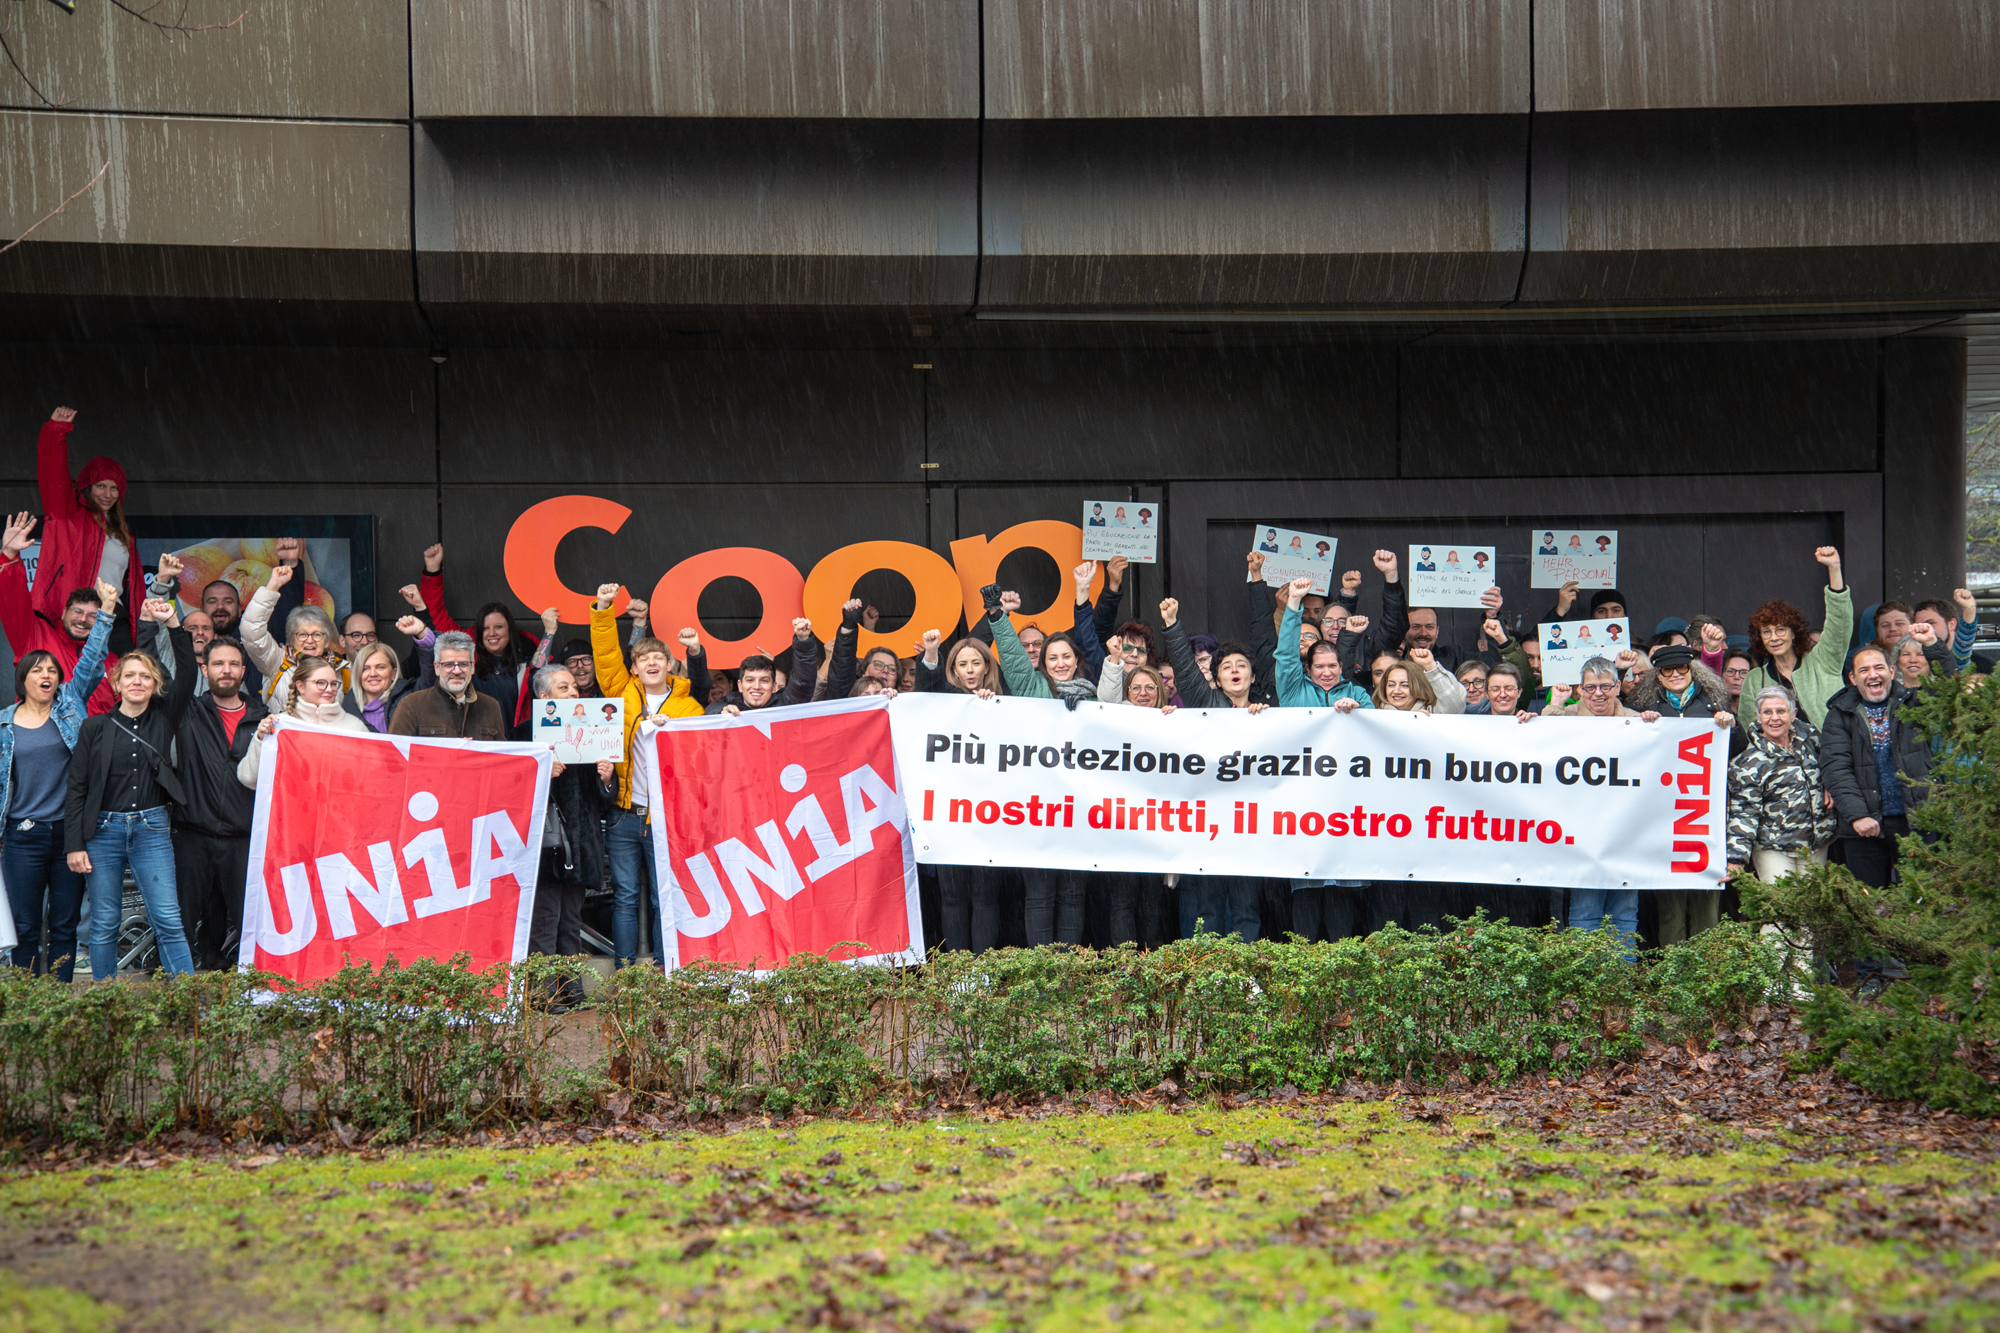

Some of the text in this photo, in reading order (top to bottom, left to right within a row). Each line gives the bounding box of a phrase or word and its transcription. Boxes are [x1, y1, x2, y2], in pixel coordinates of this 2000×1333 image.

[1542, 557, 1574, 569] MEHR
[1263, 566, 1329, 581] ECONNAISSANCE
[1548, 566, 1616, 582] PERSONAL
[927, 735, 1640, 786] Più protezione grazie a un buon CCL.
[924, 790, 1574, 844] I nostri diritti, il nostro futuro.
